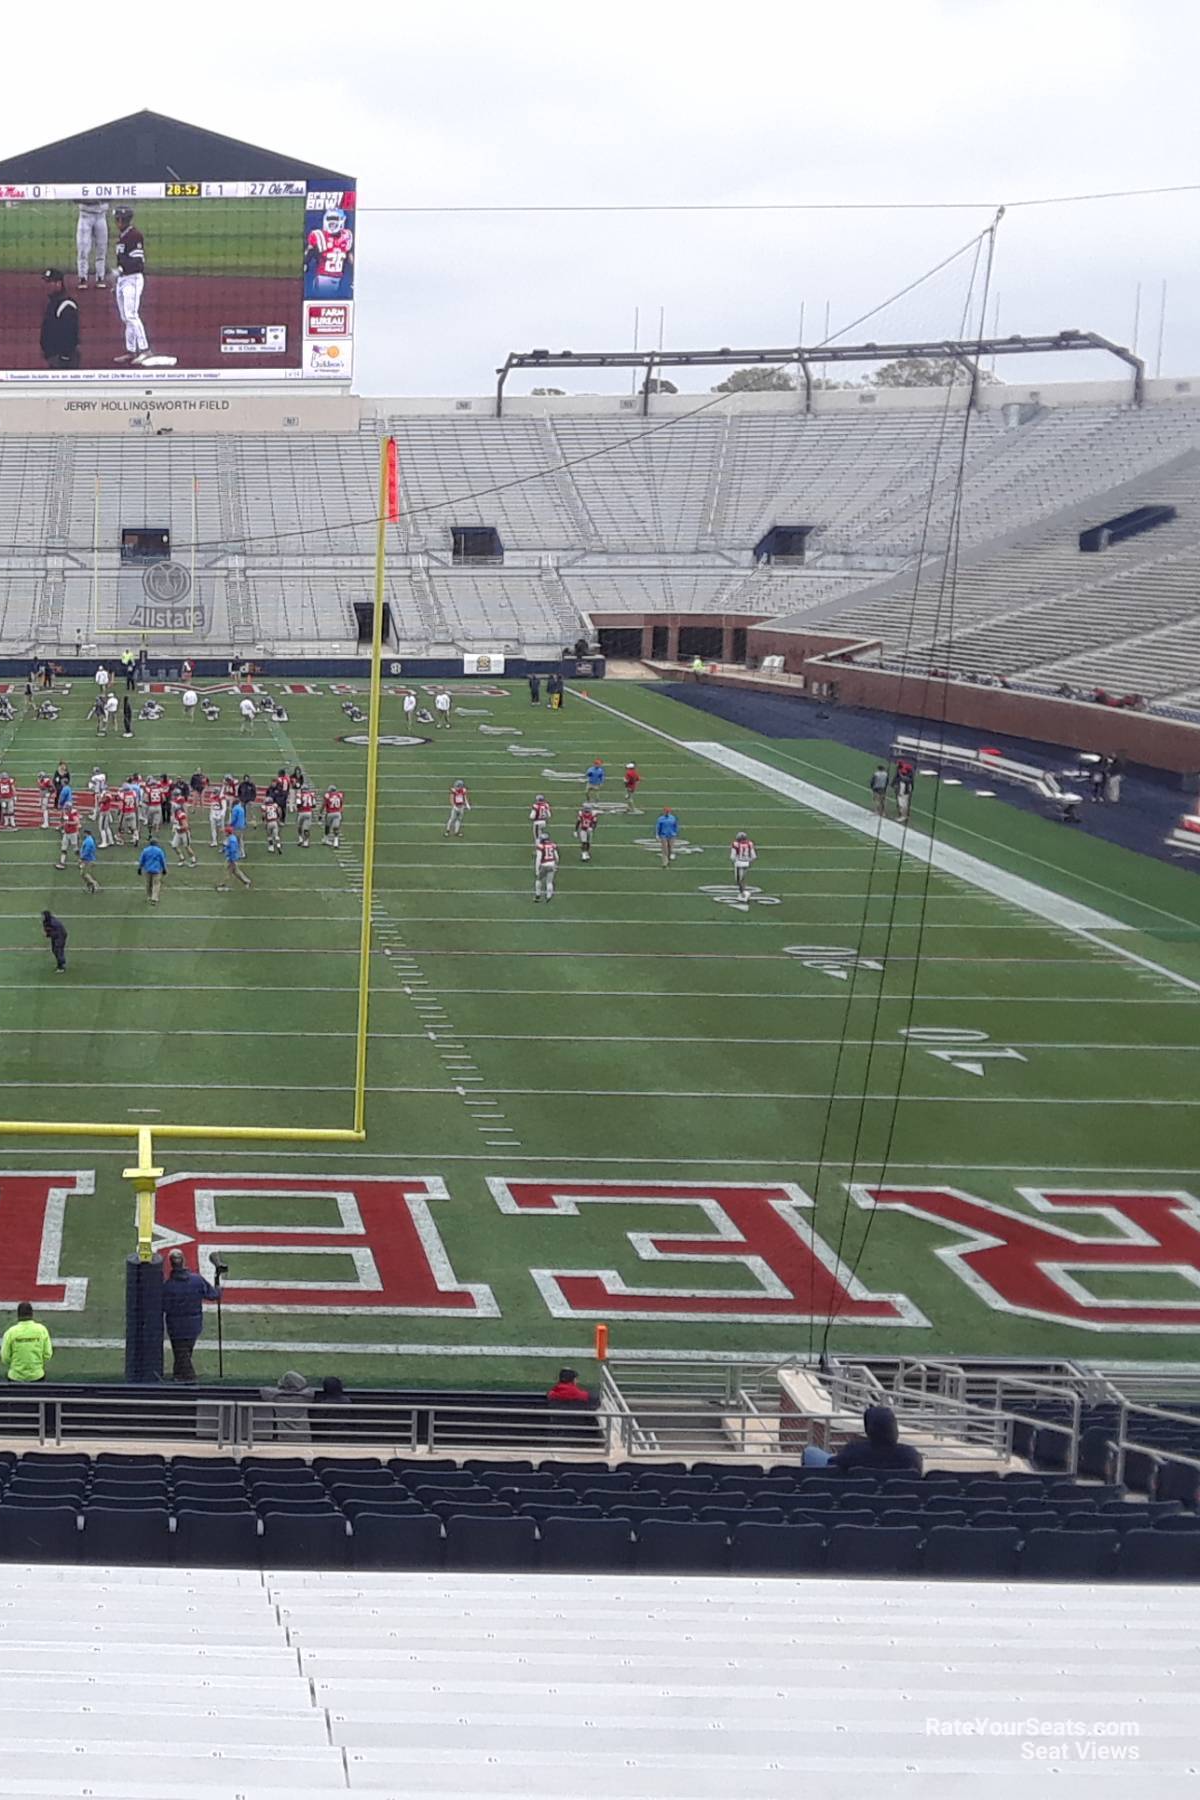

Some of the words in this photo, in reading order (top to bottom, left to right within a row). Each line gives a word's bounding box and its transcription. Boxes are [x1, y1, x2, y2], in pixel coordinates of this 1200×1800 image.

[32, 185, 41, 198] 0
[95, 185, 112, 196] ON
[117, 185, 137, 196] THE
[167, 183, 200, 196] 28:52
[250, 183, 265, 195] 27
[325, 252, 347, 272] 26
[321, 308, 345, 316] FARM
[64, 401, 97, 411] JERRY
[101, 401, 197, 411] HOLLINGSWORTH
[199, 400, 230, 410] FIELD
[131, 609, 204, 628] Allstate
[782, 945, 886, 971] 20
[898, 1027, 1029, 1063] 10
